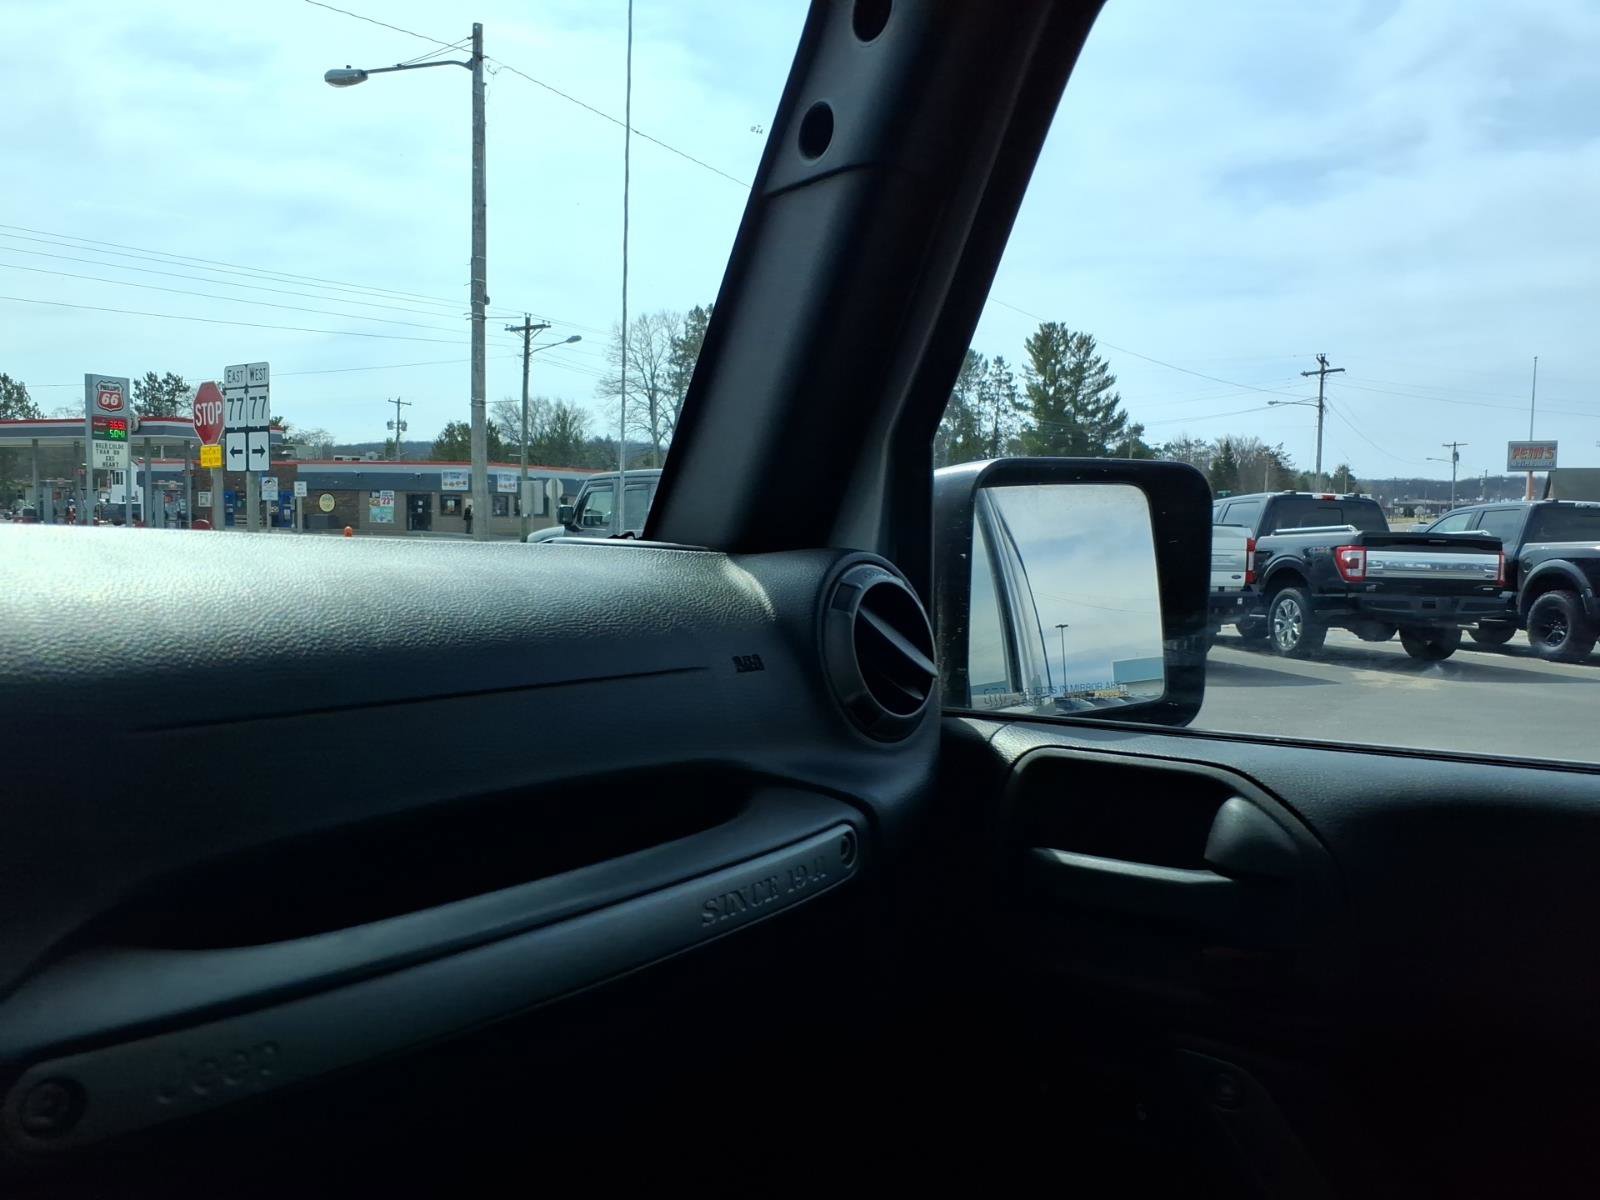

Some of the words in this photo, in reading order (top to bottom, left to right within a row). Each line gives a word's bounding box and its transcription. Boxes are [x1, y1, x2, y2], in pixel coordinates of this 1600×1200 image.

[227, 370, 243, 383] EAST
[249, 367, 266, 381] WEST
[101, 393, 119, 406] 66
[227, 397, 244, 421] 77
[249, 395, 267, 420] 77
[195, 401, 222, 427] STOP
[701, 875, 780, 928] SINCE
